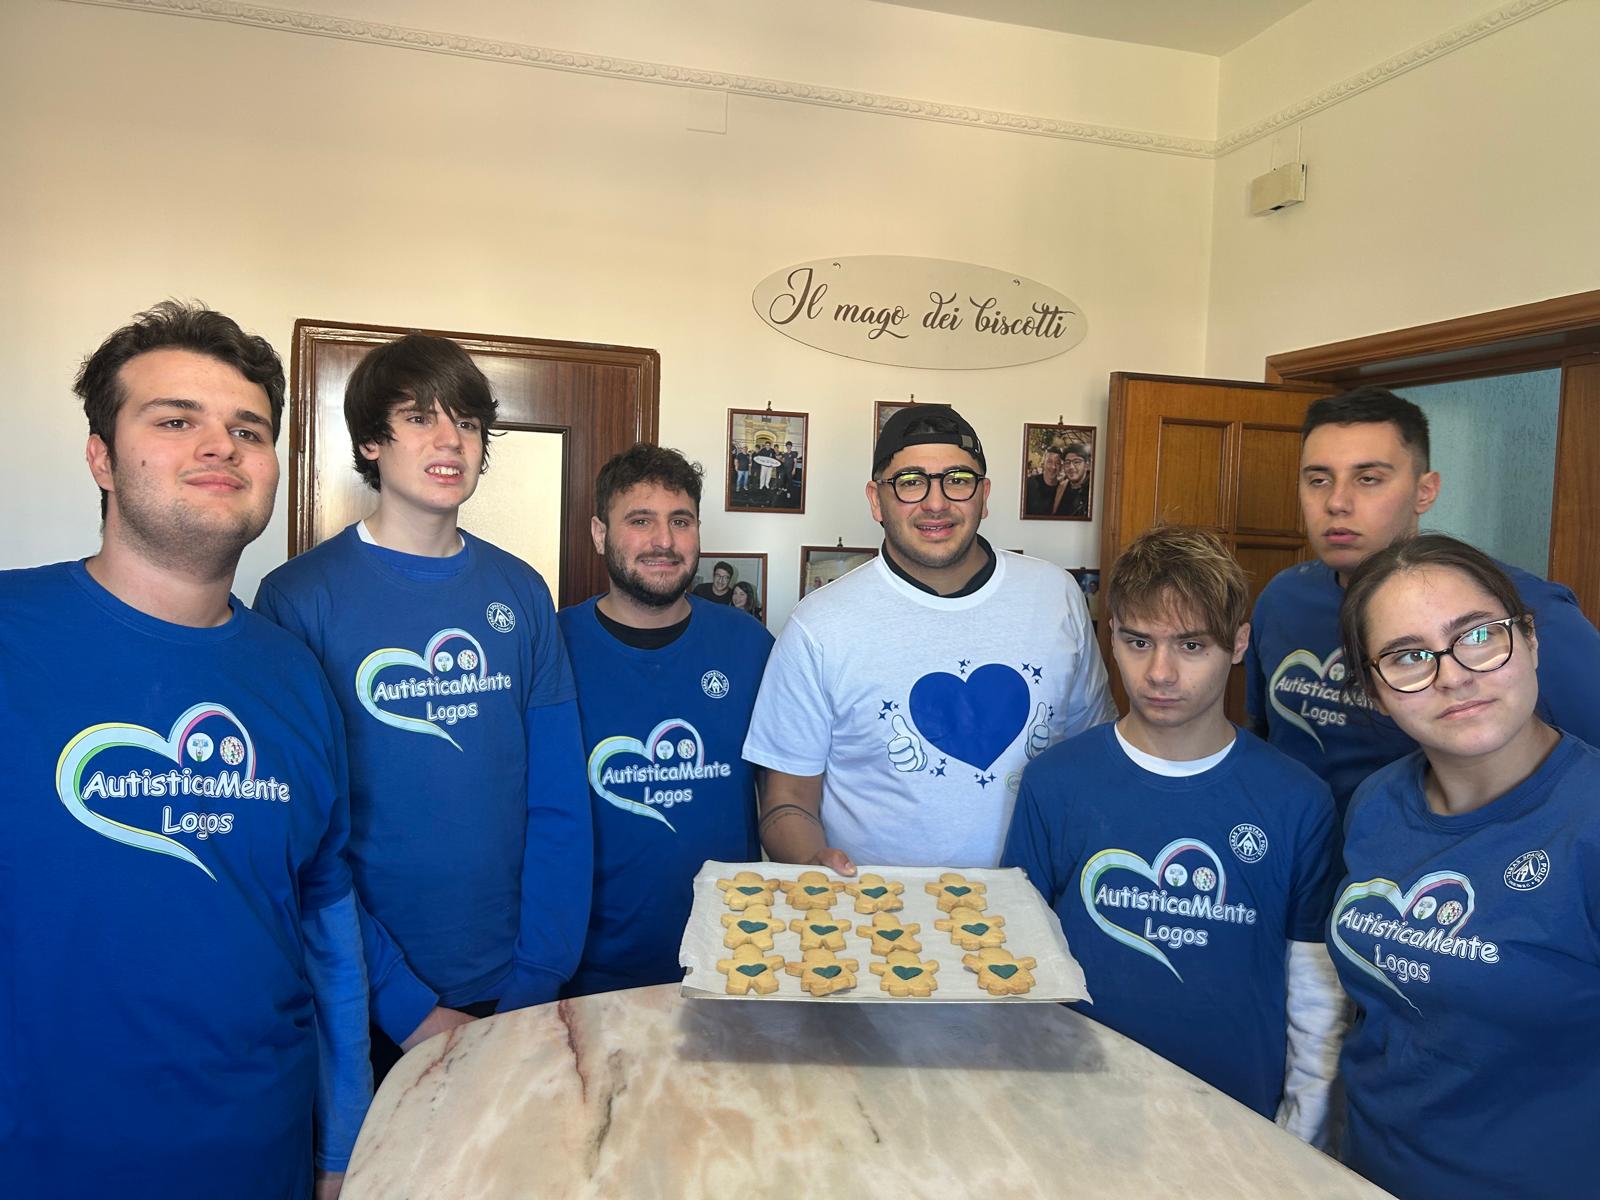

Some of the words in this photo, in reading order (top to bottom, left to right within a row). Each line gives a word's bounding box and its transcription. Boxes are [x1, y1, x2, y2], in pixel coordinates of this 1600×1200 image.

[769, 268, 828, 325] Il
[834, 302, 909, 339] mago
[922, 292, 963, 330] dei
[969, 296, 1075, 339] biscotti
[373, 672, 512, 702] AutisticaMente
[426, 701, 479, 725] Logos
[1300, 700, 1347, 726] Logos
[81, 767, 290, 802] AutisticaMente
[602, 761, 731, 785] AutisticaMente
[644, 786, 693, 808] Logos
[161, 806, 235, 840] Logos
[1534, 862, 1547, 883] POLIS
[1095, 883, 1257, 925] AutisticaMente
[1144, 917, 1209, 949] Logos
[1337, 907, 1500, 964] AutisticaMente
[1373, 944, 1431, 983] Logos
